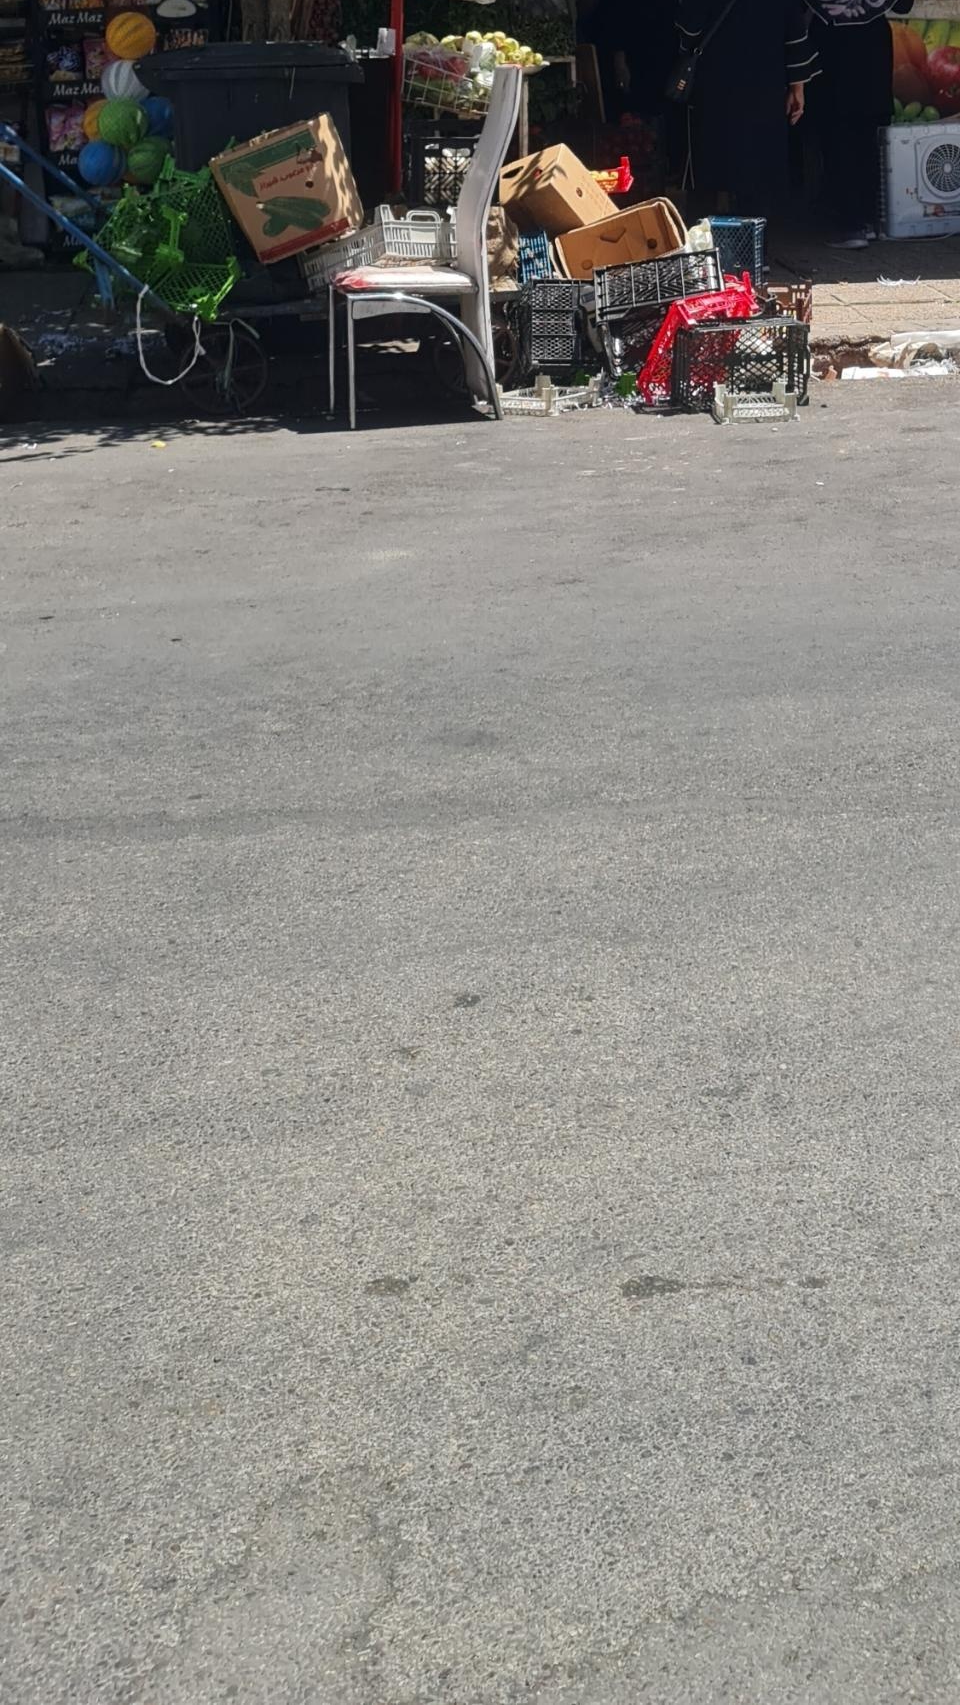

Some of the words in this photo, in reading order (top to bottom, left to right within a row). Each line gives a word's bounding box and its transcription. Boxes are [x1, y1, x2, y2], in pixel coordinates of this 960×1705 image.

[48, 13, 75, 25] Maz
[76, 12, 103, 24] Maz
[53, 84, 80, 96] Maz
[58, 155, 77, 166] Ma
